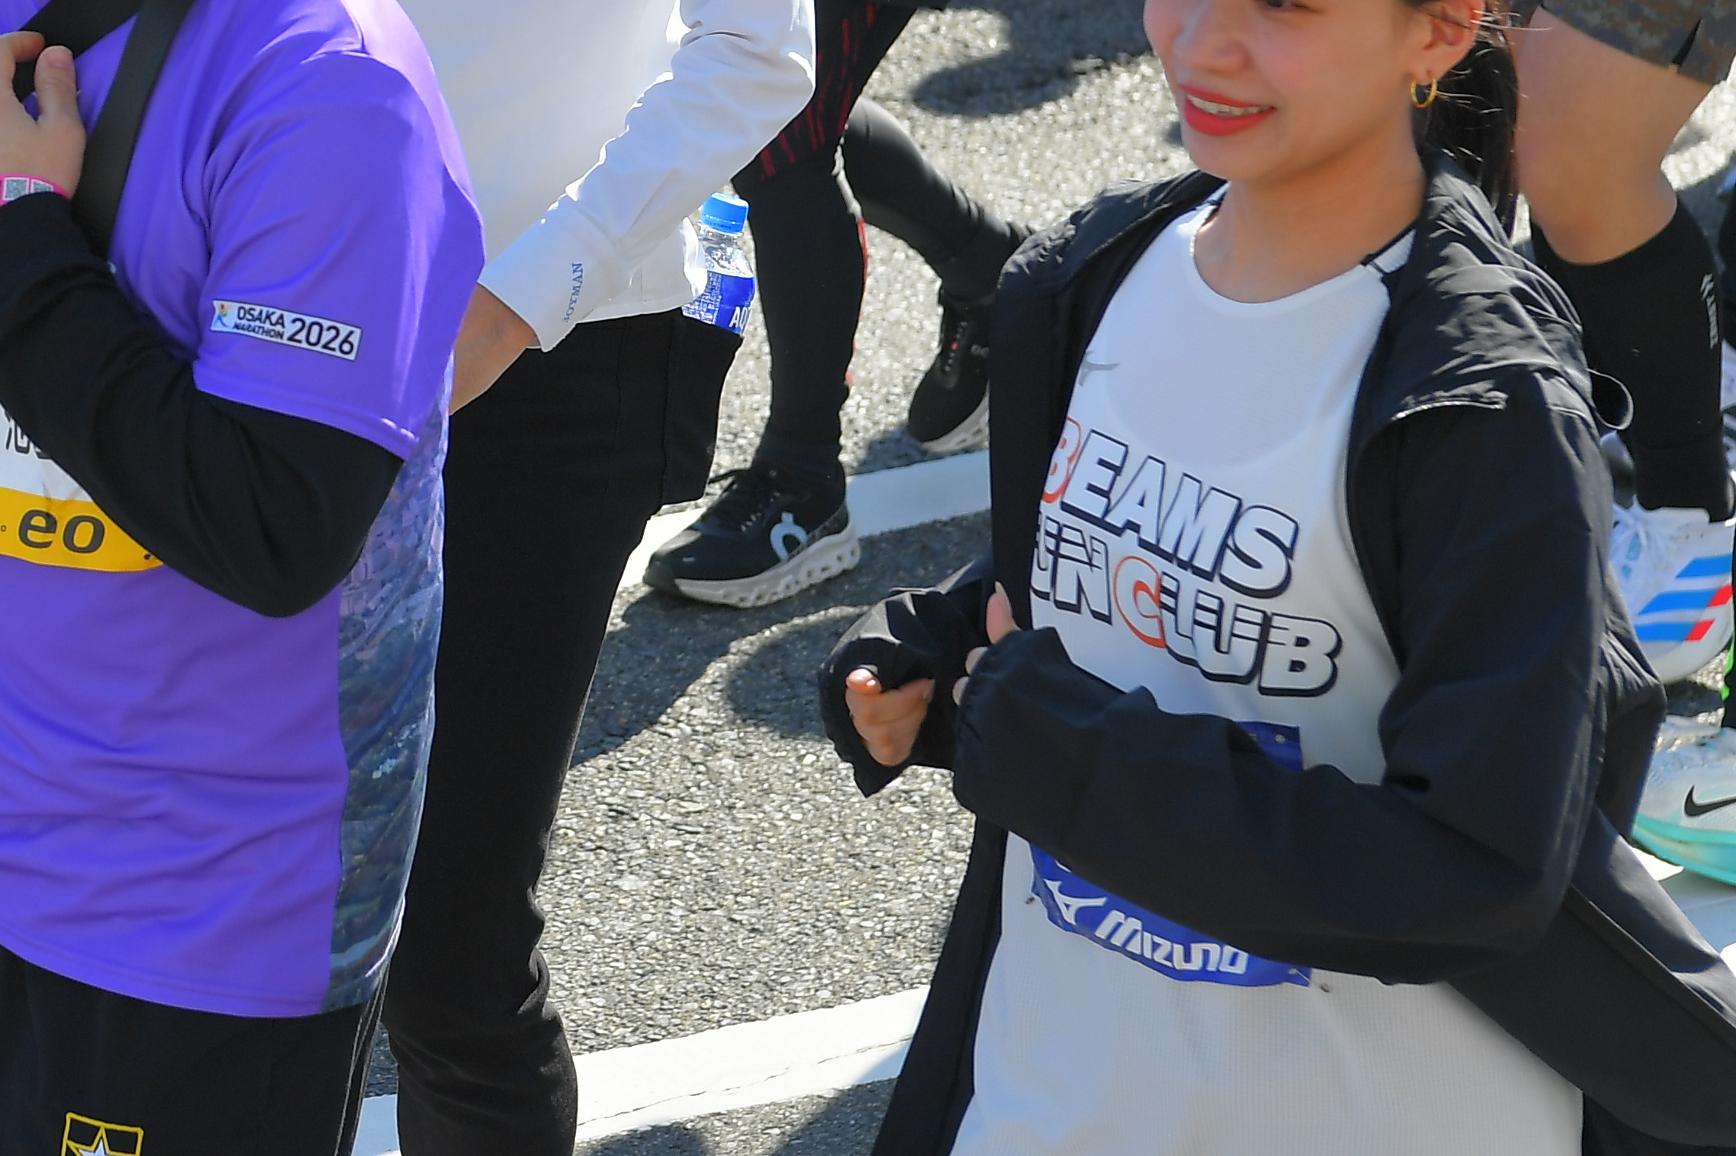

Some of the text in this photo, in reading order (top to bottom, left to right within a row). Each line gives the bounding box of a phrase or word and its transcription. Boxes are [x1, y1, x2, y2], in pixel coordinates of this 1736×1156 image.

[236, 305, 356, 357] OSAKA 2026
[18, 509, 106, 554] eo
[1042, 416, 1299, 600] BEAMS
[1114, 555, 1342, 698] CLUB
[1093, 910, 1251, 975] MIZUNO
